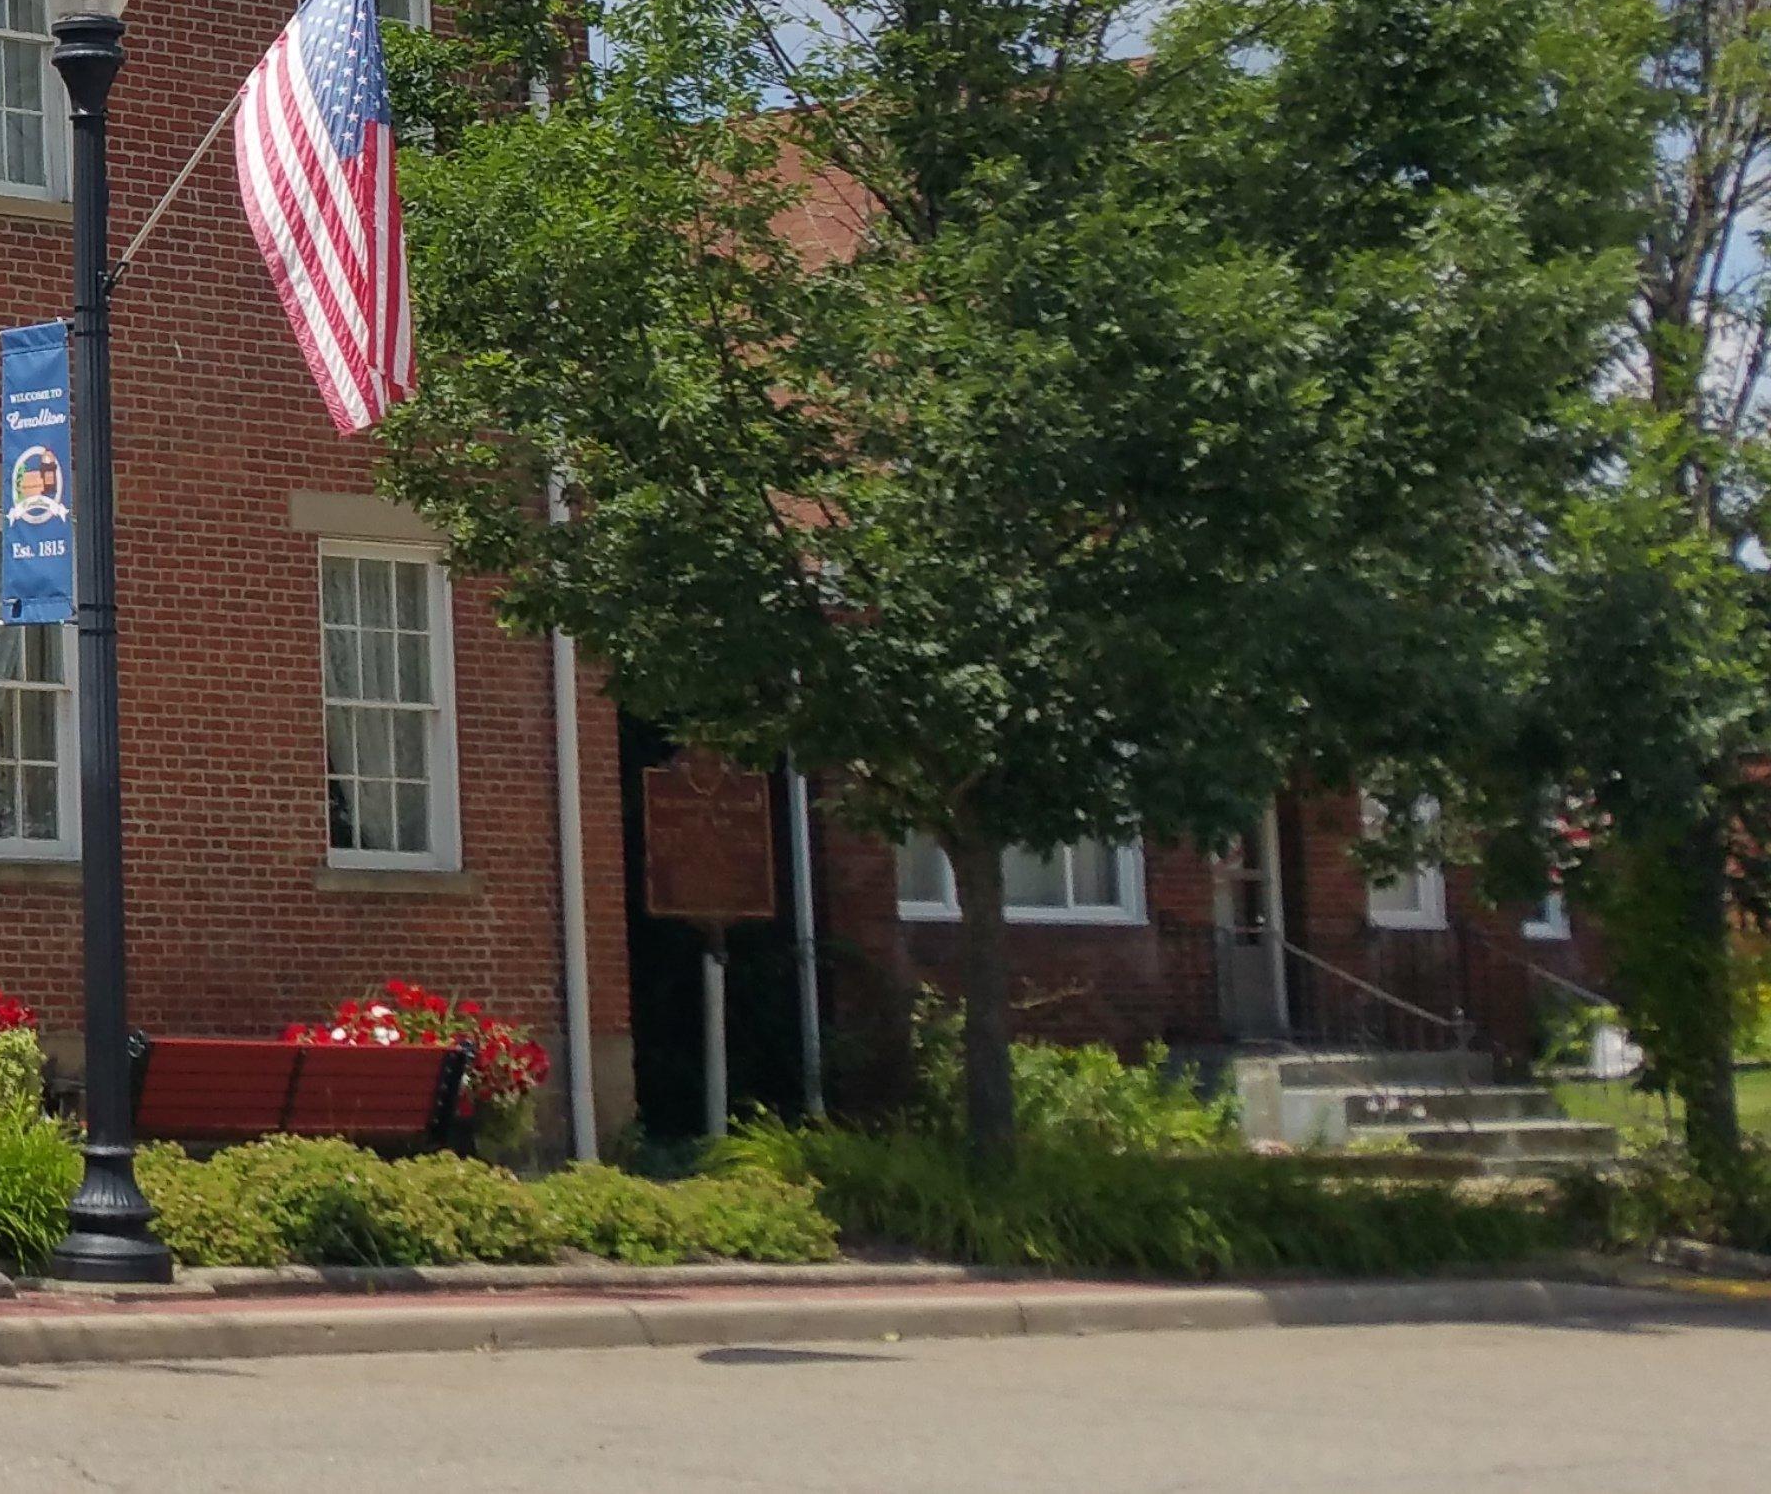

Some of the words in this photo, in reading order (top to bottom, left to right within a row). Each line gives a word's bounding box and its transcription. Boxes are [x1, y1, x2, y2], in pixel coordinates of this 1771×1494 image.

[10, 391, 51, 403] WELCOME
[50, 388, 62, 399] TO
[12, 542, 35, 559] Est.
[39, 539, 65, 557] 1815
